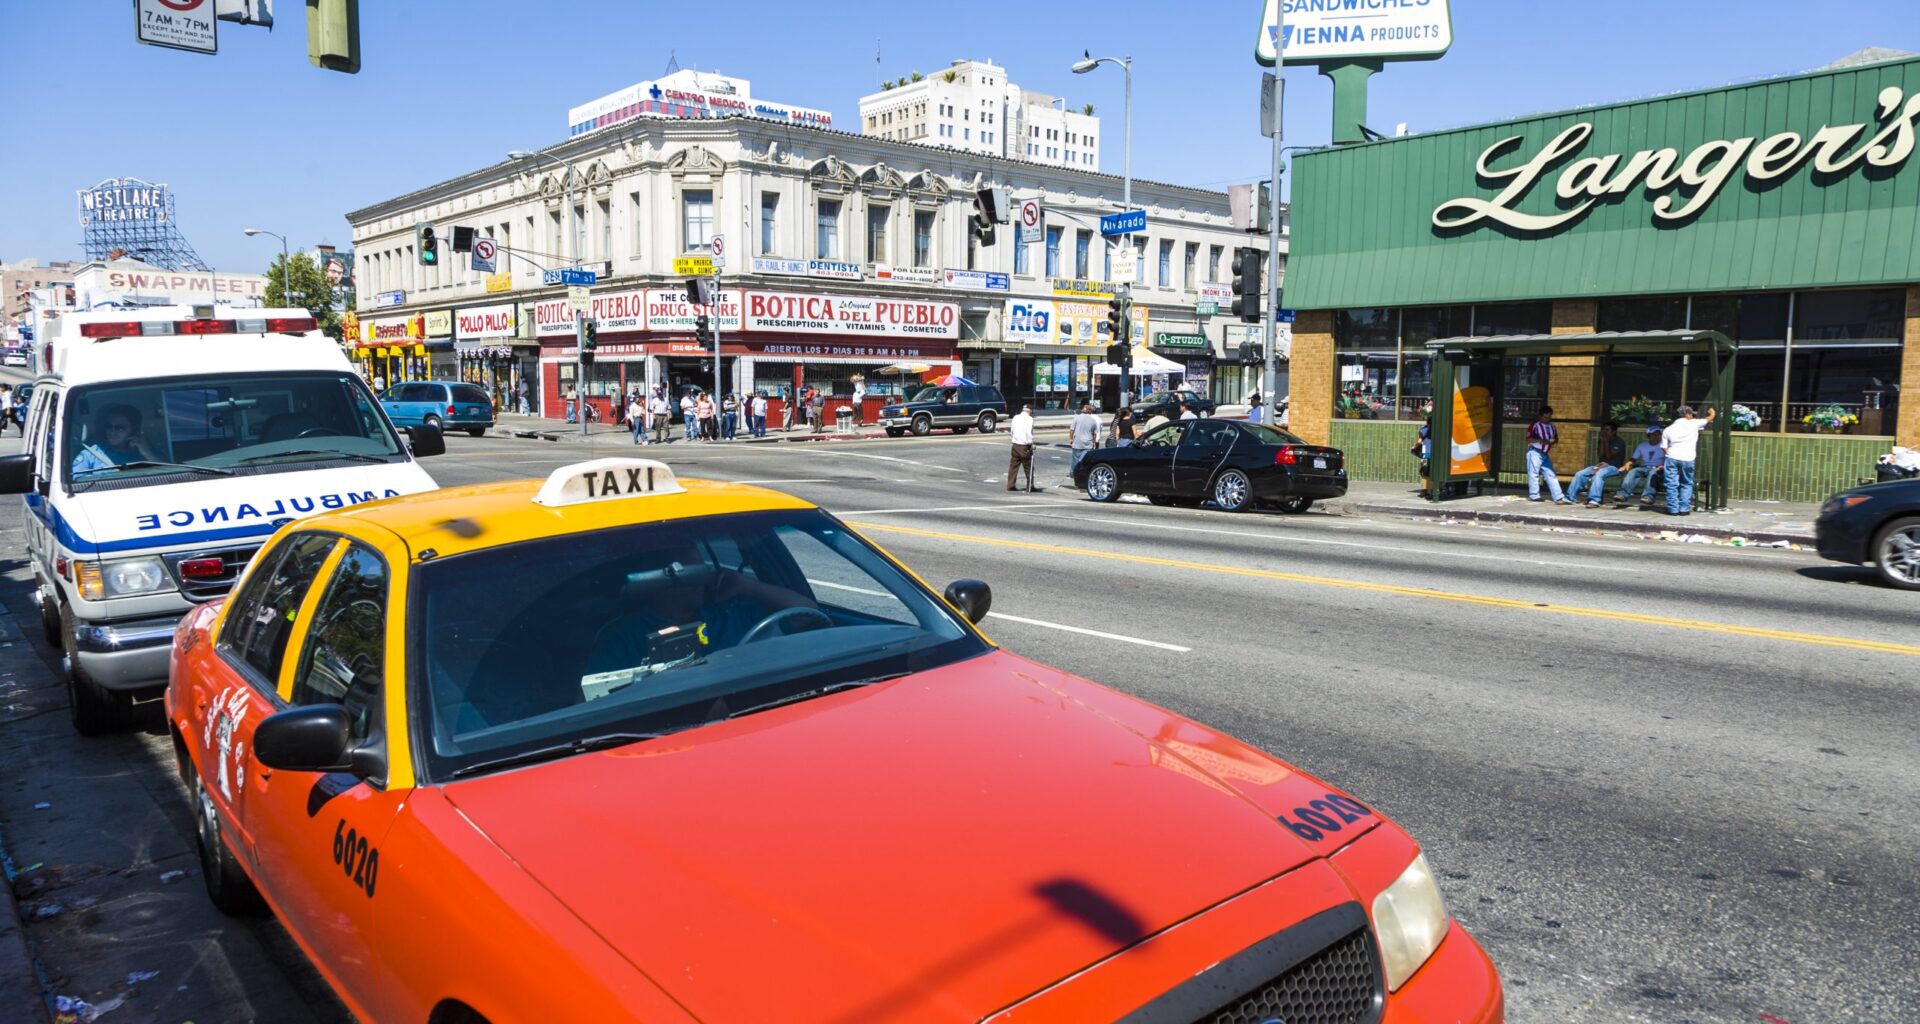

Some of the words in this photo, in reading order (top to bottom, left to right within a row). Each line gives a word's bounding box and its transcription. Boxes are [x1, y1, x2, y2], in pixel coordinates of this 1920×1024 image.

[143, 23, 168, 32] EXCEPT
[144, 10, 153, 22] 7
[155, 14, 173, 25] AM
[183, 17, 191, 28] 7
[193, 20, 209, 32] PM
[1370, 24, 1439, 41] PRODUCTS
[664, 88, 705, 103] CENTRO
[708, 95, 746, 110] MEDICO
[1431, 86, 1920, 230] Langer's
[82, 188, 162, 210] WESTLAKE
[96, 206, 150, 222] THEATRE
[1102, 217, 1144, 231] Alvarado
[765, 260, 780, 271] RAUL
[809, 260, 859, 273] DENTISTA
[109, 272, 262, 295] SWAPMEET
[563, 272, 580, 283] 7th
[583, 274, 593, 283] St
[1053, 279, 1071, 291] CLINICA
[659, 294, 677, 302] THE
[1201, 288, 1220, 297] INCOME
[537, 302, 574, 325] BOTICA
[592, 294, 641, 319] PUEBLO
[649, 303, 687, 317] DRUG
[750, 294, 833, 320] BOTICA
[839, 309, 871, 322] DEL
[875, 302, 954, 326] PUEBLO
[429, 316, 442, 329] Sprint
[459, 314, 483, 334] POLLO
[484, 312, 508, 331] PILLO
[541, 323, 573, 332] PRESCRIPTIONS
[608, 318, 637, 328] COSMETICS
[649, 317, 669, 325] HERBS
[676, 317, 698, 325] HIERBA
[756, 318, 829, 329] PRESCRIPTIONS
[845, 322, 886, 332] VITAMINS
[902, 325, 948, 334] COSMETICS
[1010, 303, 1049, 333] Ria
[1158, 333, 1204, 345] Q-STUDIO
[763, 345, 802, 353] ABIERTO
[805, 346, 821, 354] LOS
[824, 346, 830, 354] 7
[832, 347, 852, 355] DIAS
[854, 347, 865, 355] DE
[876, 348, 889, 356] AM
[891, 348, 897, 356] A
[1355, 367, 1361, 376] A
[583, 466, 654, 497] TAXI
[1276, 794, 1372, 842] 6020
[333, 818, 379, 898] 6020
